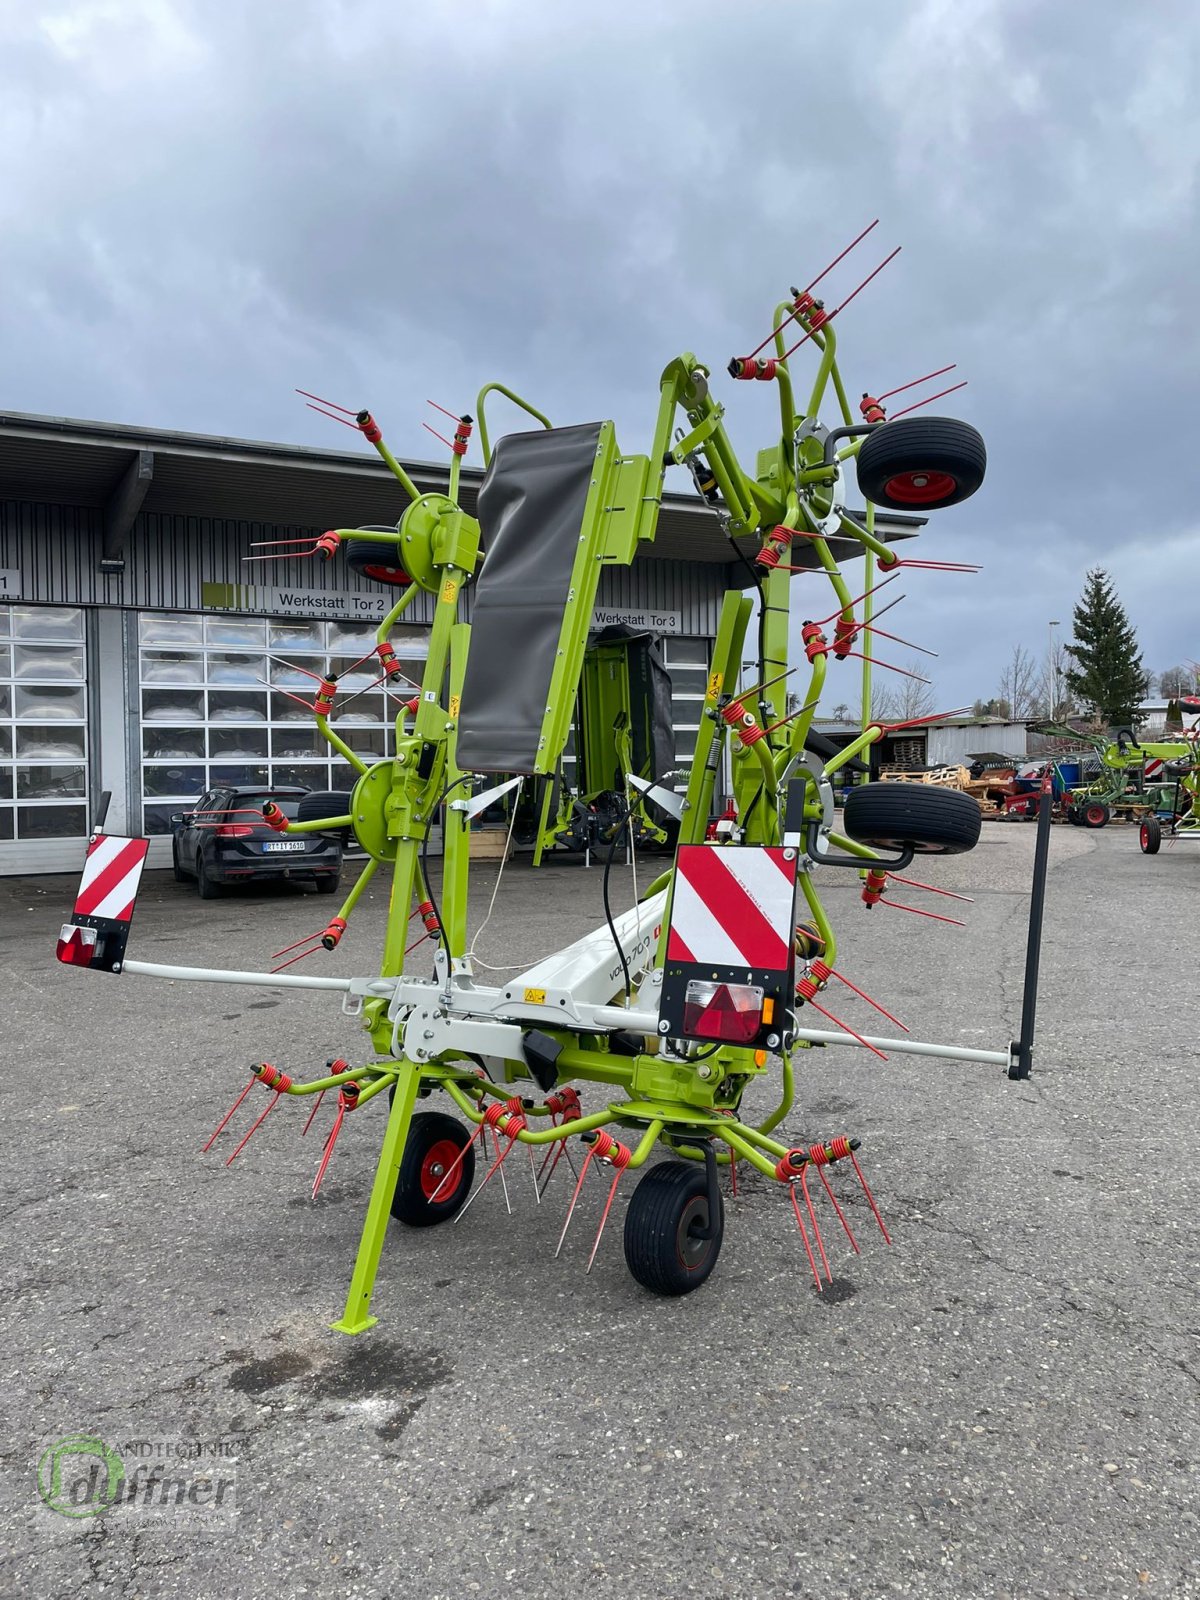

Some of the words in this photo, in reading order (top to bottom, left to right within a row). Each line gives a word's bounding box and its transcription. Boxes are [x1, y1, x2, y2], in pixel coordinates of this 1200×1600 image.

[0, 576, 7, 589] 1
[279, 593, 345, 609] Werkstatt
[352, 597, 373, 610] Tor
[376, 599, 385, 611] 2
[595, 612, 645, 625] Werkstatt
[650, 615, 667, 626] Tor
[669, 616, 676, 627] 3
[609, 955, 632, 981] VOLO
[632, 935, 651, 961] 700
